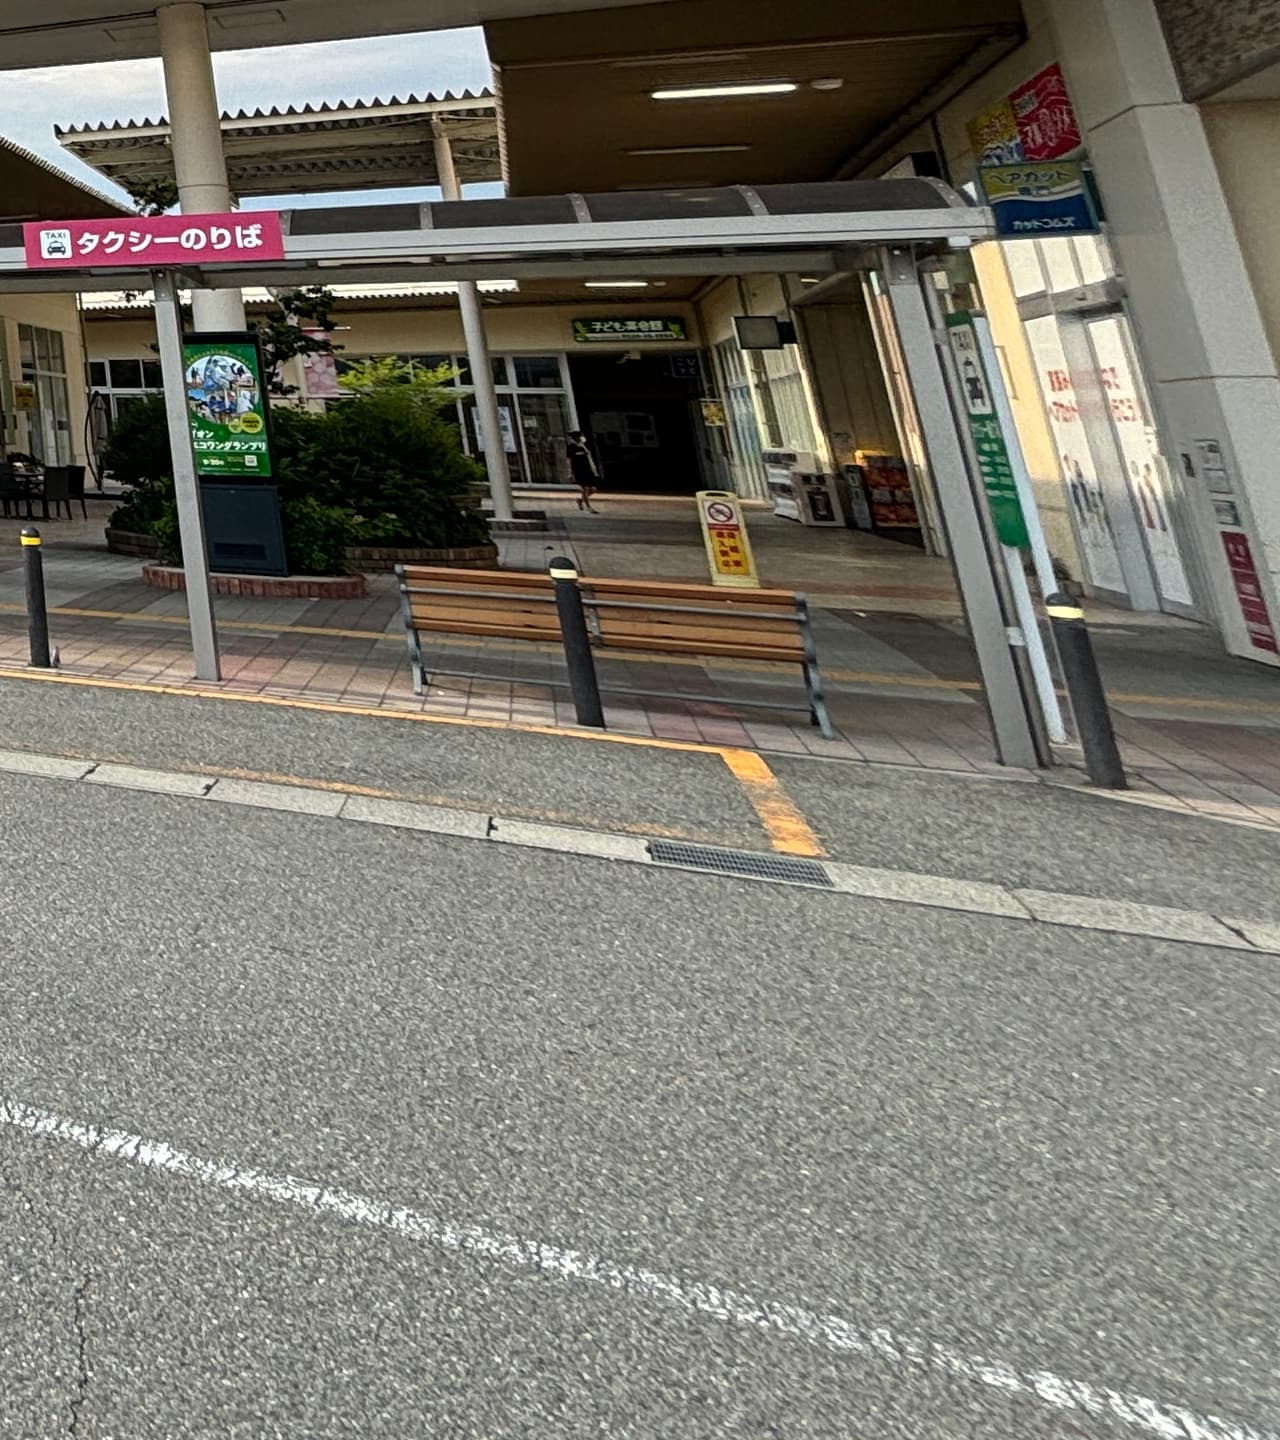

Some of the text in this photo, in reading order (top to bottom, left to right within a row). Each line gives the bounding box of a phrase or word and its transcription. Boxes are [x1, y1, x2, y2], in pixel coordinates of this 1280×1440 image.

[45, 232, 68, 240] TAXI
[76, 223, 264, 256] タクシーのりば
